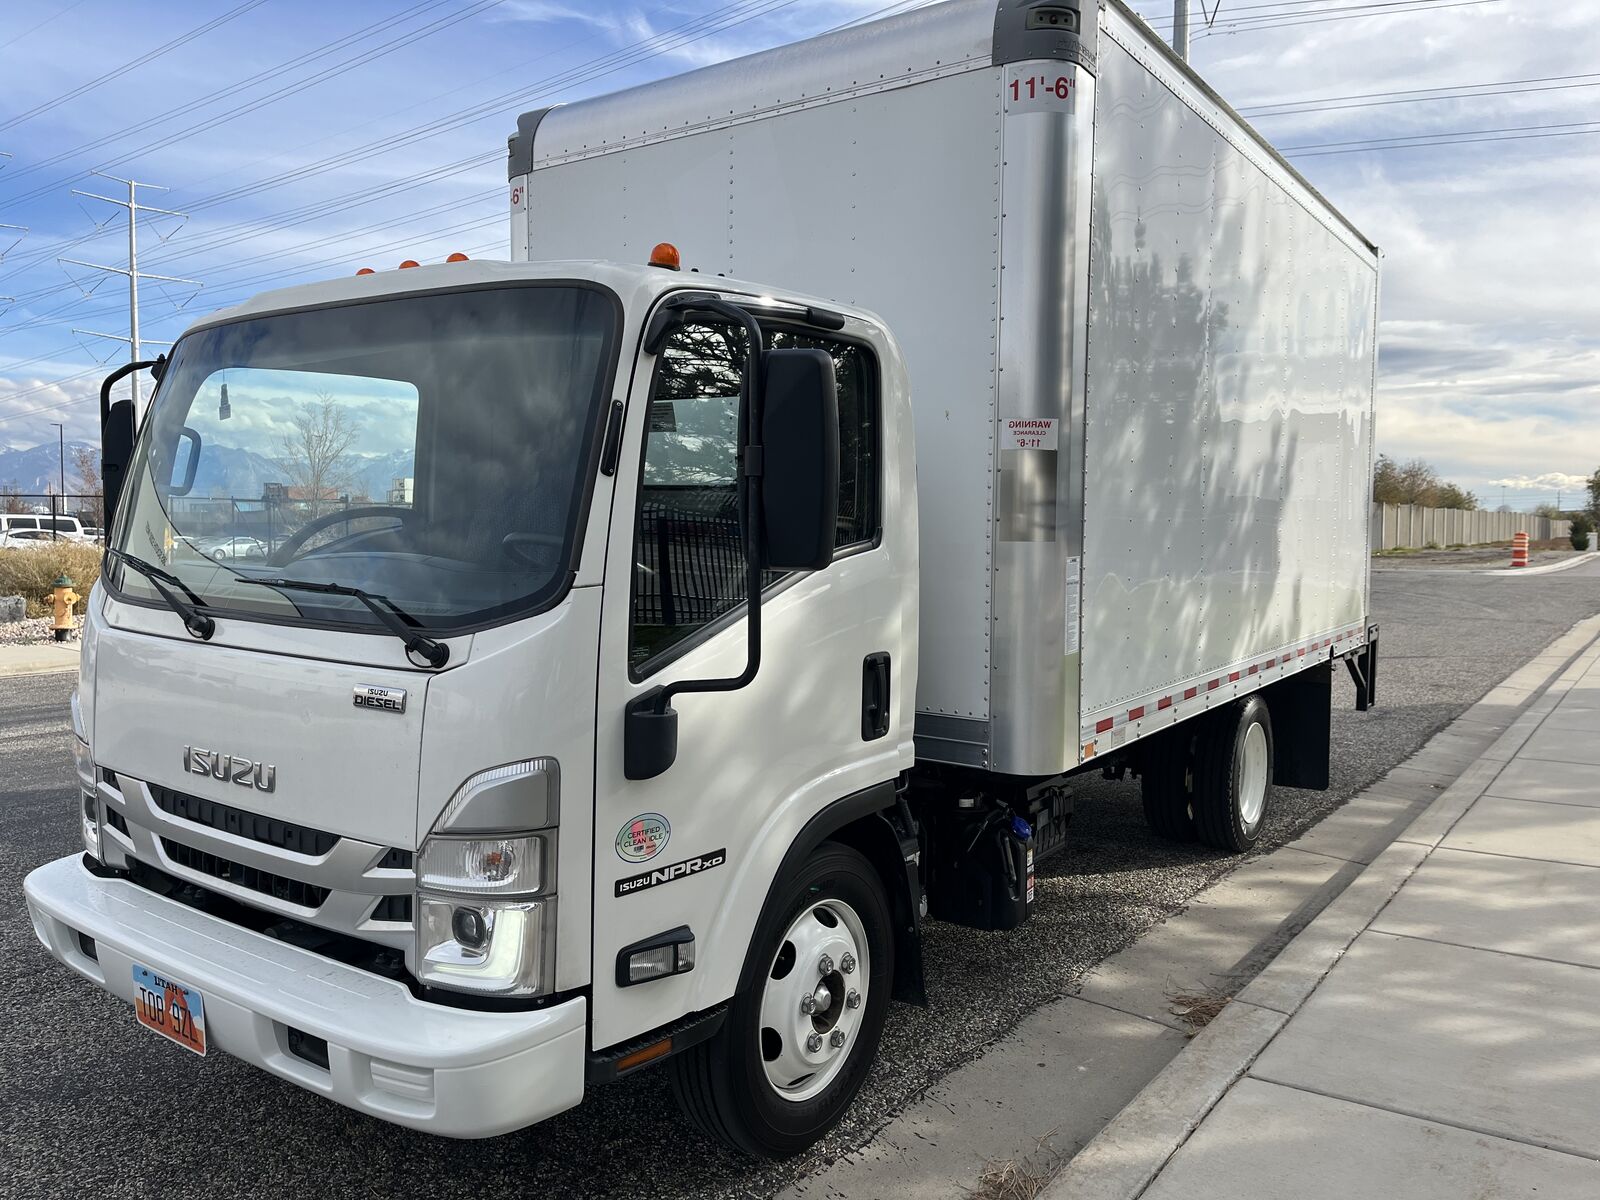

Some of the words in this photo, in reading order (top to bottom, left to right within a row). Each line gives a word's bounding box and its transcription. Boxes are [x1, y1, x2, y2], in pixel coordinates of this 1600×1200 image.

[1009, 76, 1075, 101] 11'-6"
[367, 688, 389, 697] ISUZU
[354, 694, 401, 710] DIESEL
[183, 744, 277, 794] ISUZU
[623, 836, 647, 848] CLEAN
[649, 832, 664, 842] IDLE
[627, 826, 661, 840] CERTIFIED
[619, 876, 650, 892] ISUZU
[153, 975, 178, 995] UTAH
[172, 1002, 198, 1043] 9ZL
